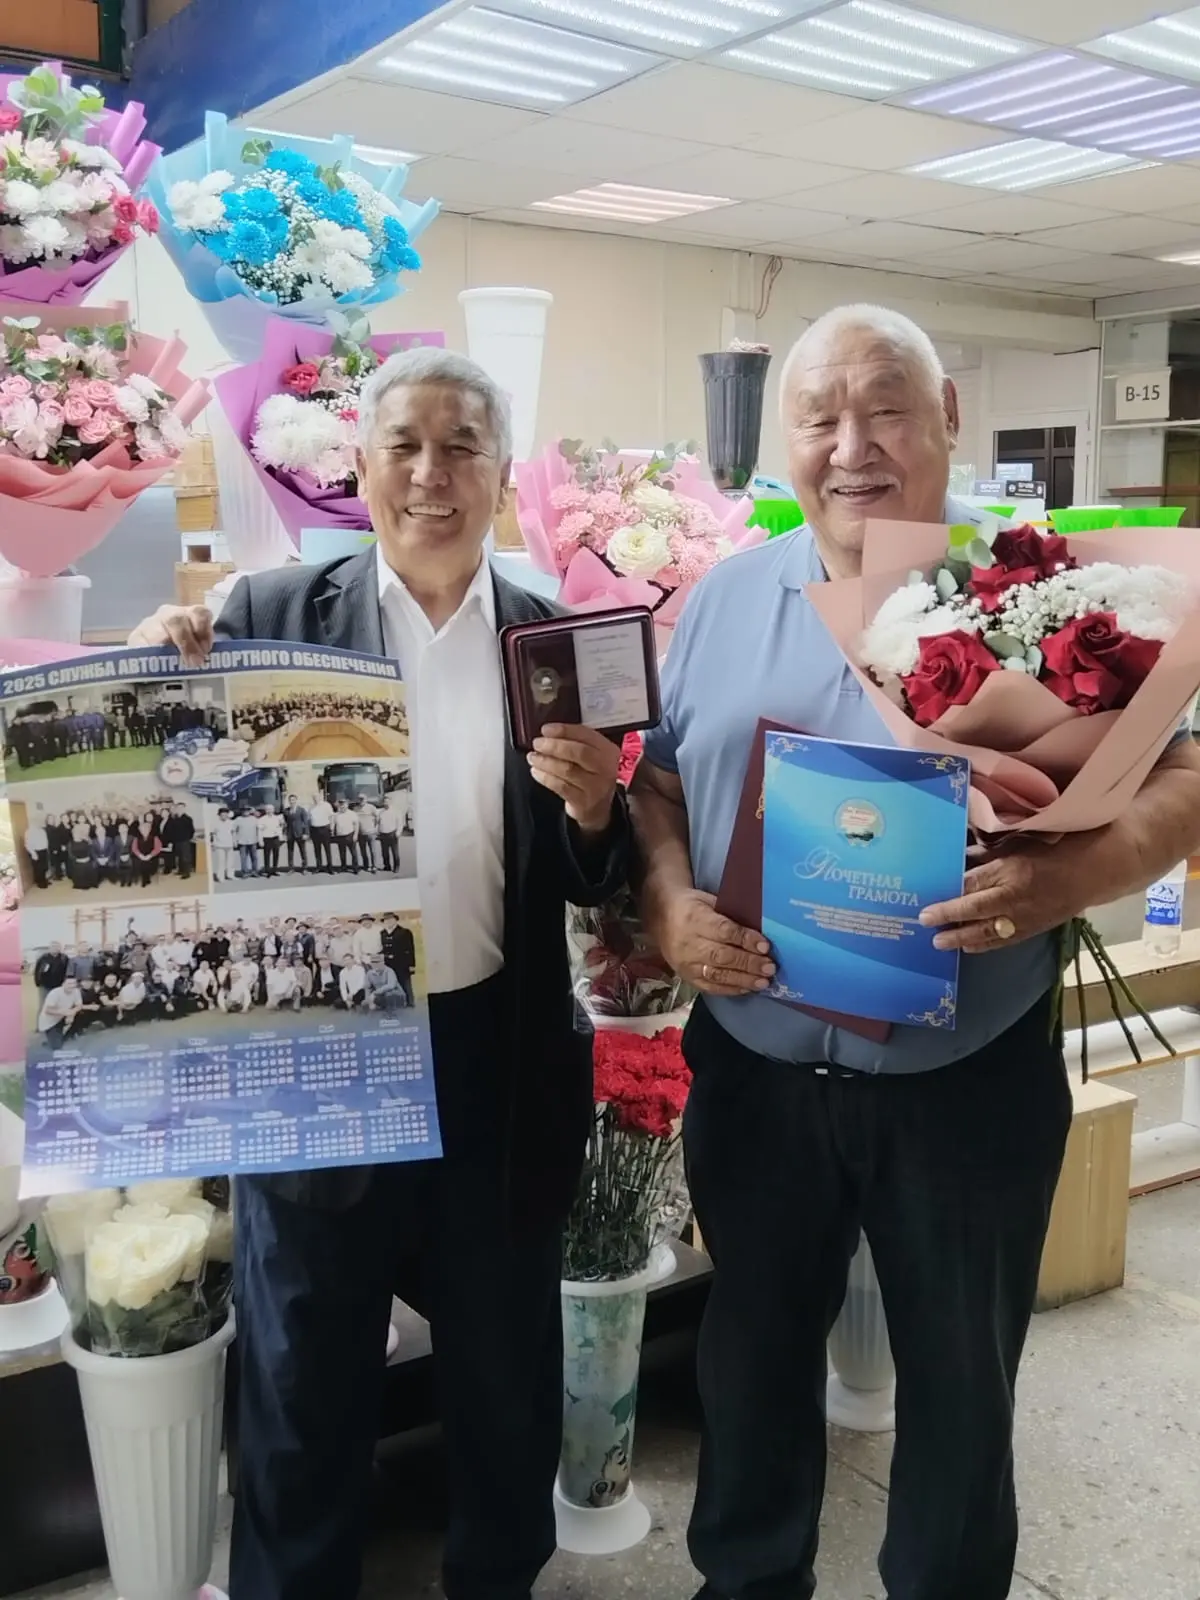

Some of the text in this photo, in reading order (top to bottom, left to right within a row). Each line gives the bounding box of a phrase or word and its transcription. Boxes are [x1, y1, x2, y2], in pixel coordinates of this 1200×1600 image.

[3, 673, 45, 695] 2025
[47, 660, 117, 686] СЛУЖБА
[292, 651, 397, 677] ОБЕСПЕЧЕНИЯ
[848, 885, 919, 906] ГРАМОТА
